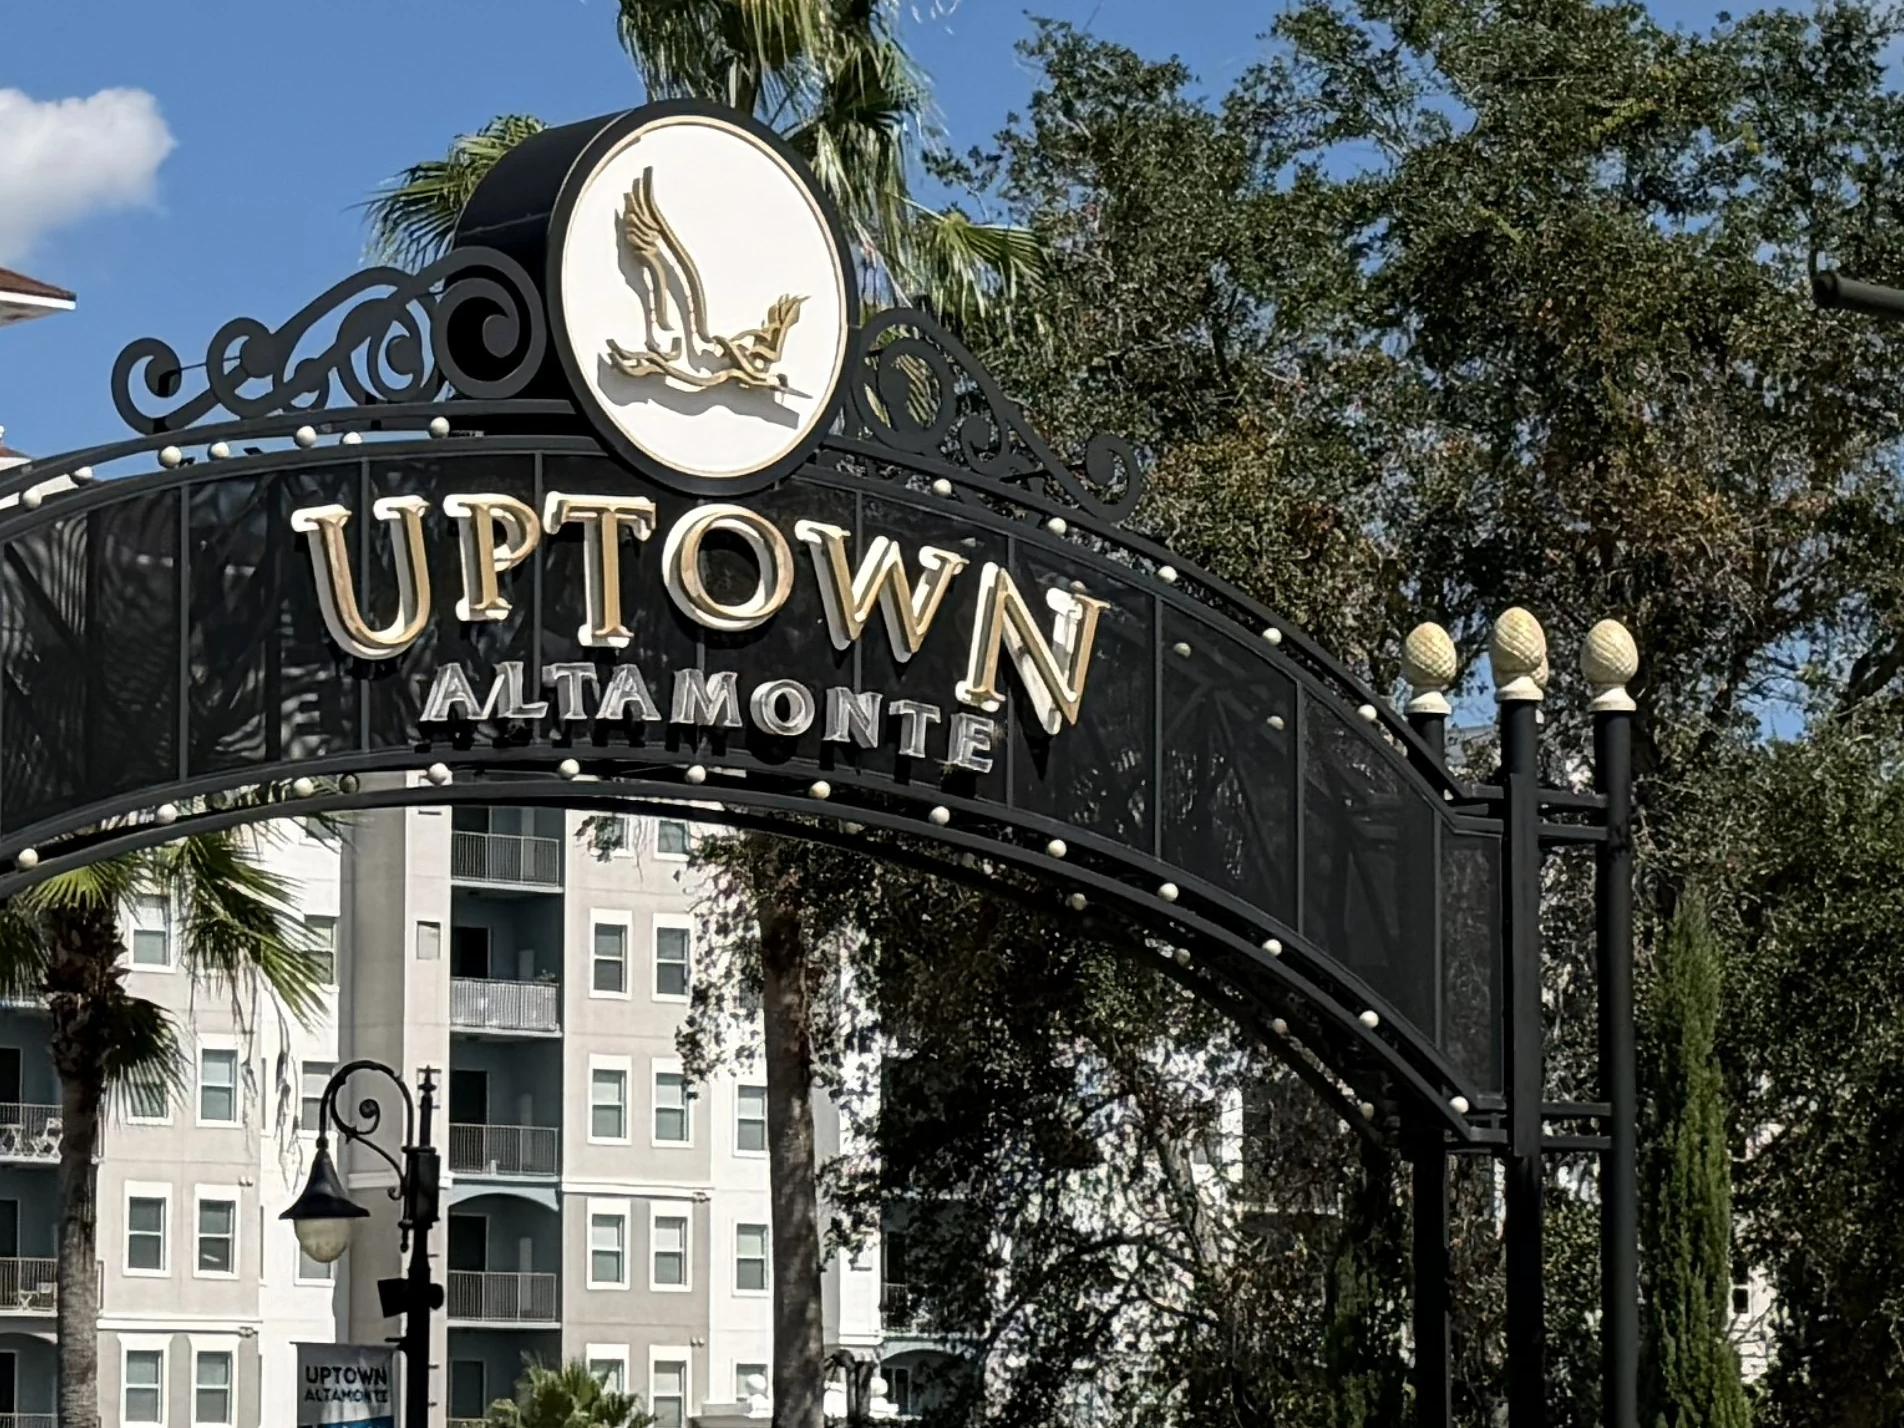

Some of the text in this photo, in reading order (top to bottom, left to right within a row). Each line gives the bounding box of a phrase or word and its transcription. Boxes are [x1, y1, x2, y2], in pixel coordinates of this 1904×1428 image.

[291, 491, 1111, 735] UPTOWN
[419, 660, 995, 773] ALTAMONTE
[303, 1387, 389, 1403] ALTAMONTE
[304, 1365, 388, 1385] UPTOWN
